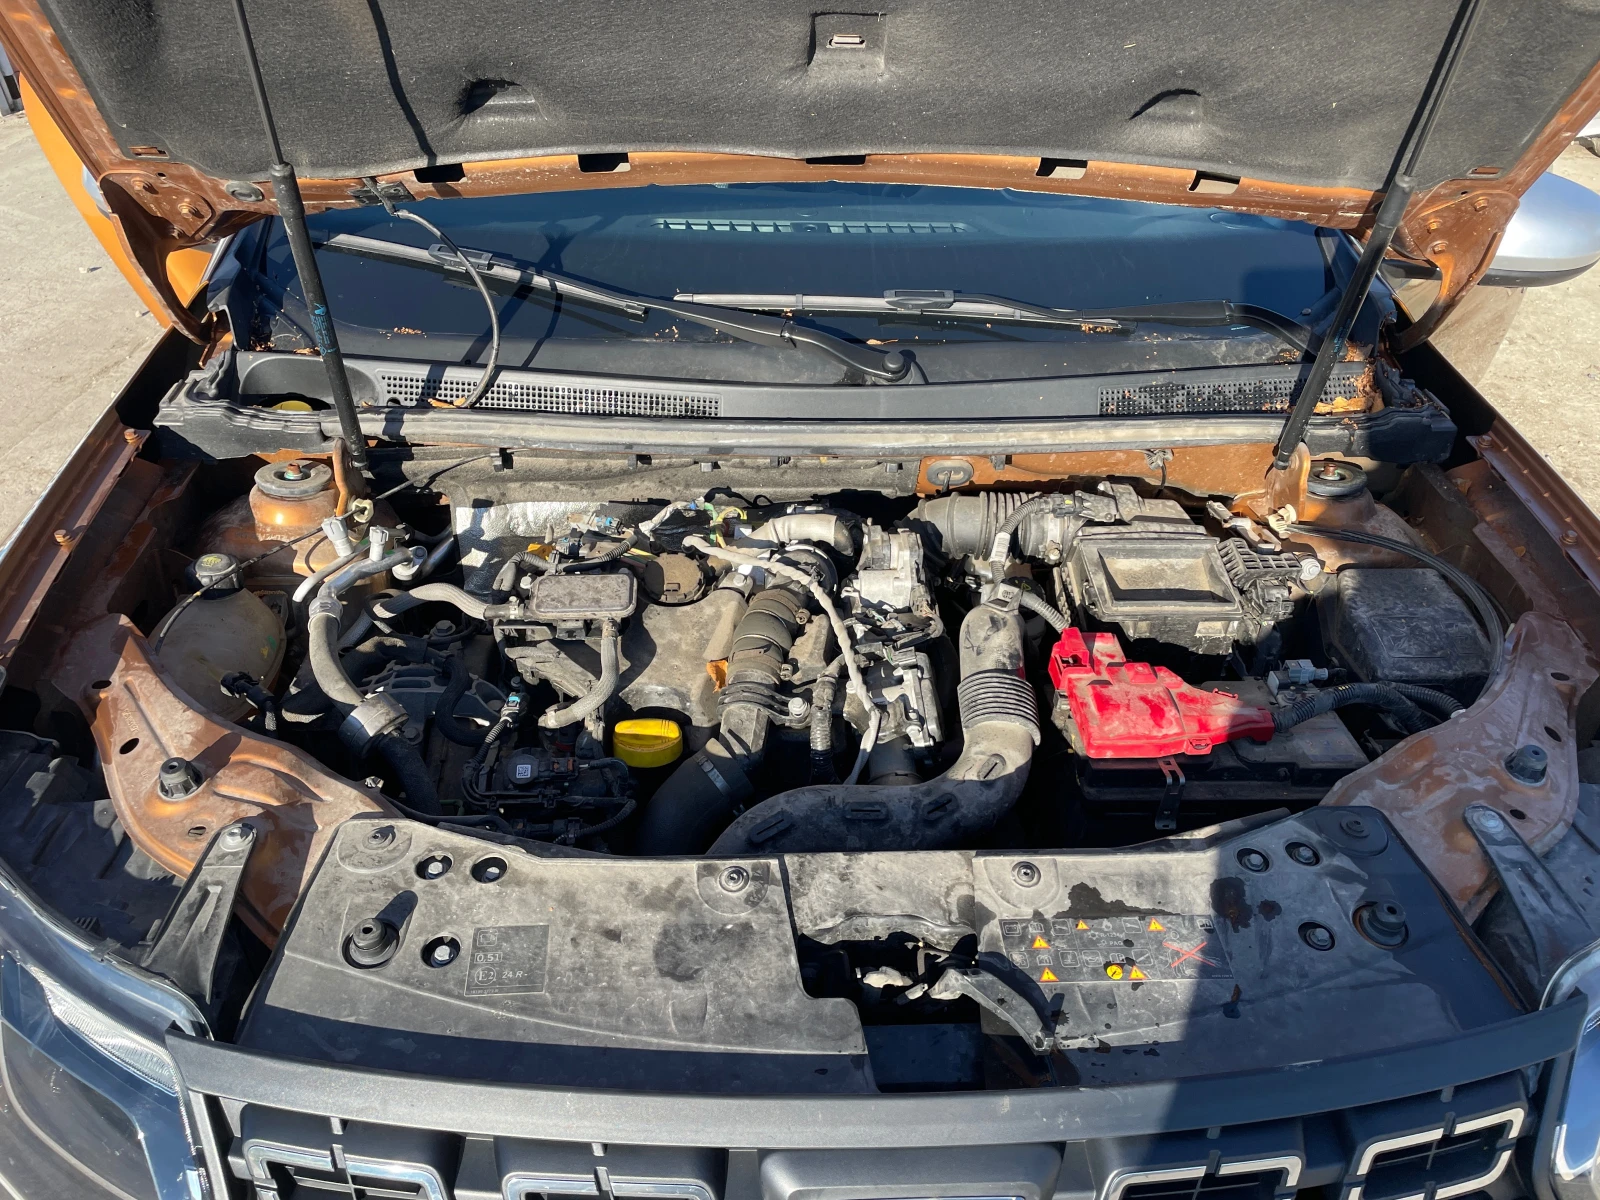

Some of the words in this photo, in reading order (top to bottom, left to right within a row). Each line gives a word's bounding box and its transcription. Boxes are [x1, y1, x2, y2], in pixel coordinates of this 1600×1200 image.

[476, 953, 499, 963] 0,51
[478, 970, 494, 981] E2
[501, 970, 513, 979] 24
